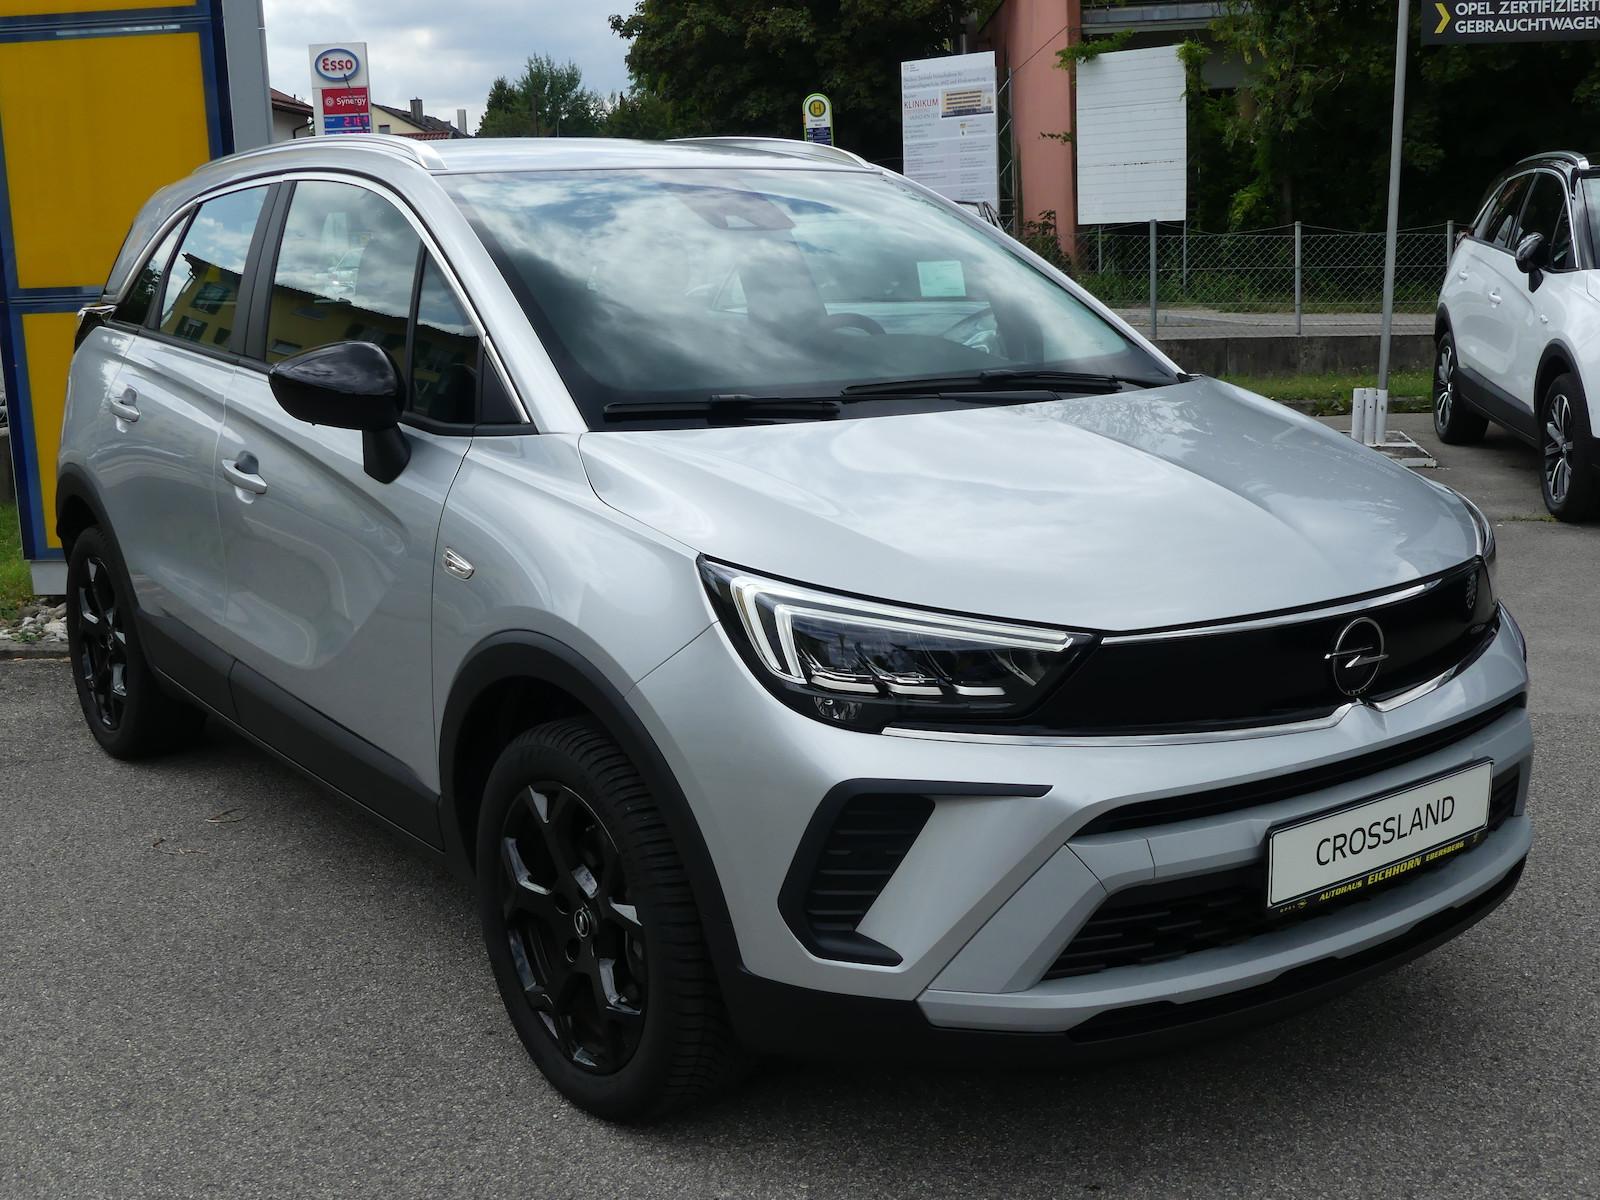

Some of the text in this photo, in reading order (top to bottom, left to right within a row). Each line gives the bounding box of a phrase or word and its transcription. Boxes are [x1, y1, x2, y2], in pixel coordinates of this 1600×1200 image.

[1455, 2, 1495, 15] OPEL
[322, 57, 353, 71] Esso
[336, 98, 366, 106] Synergy
[813, 103, 822, 113] H
[903, 98, 939, 109] KLINIKUM
[1316, 796, 1455, 866] CROSSLAND
[1319, 841, 1465, 901] AUTOHAUS EICHHORN EBERSBERG
